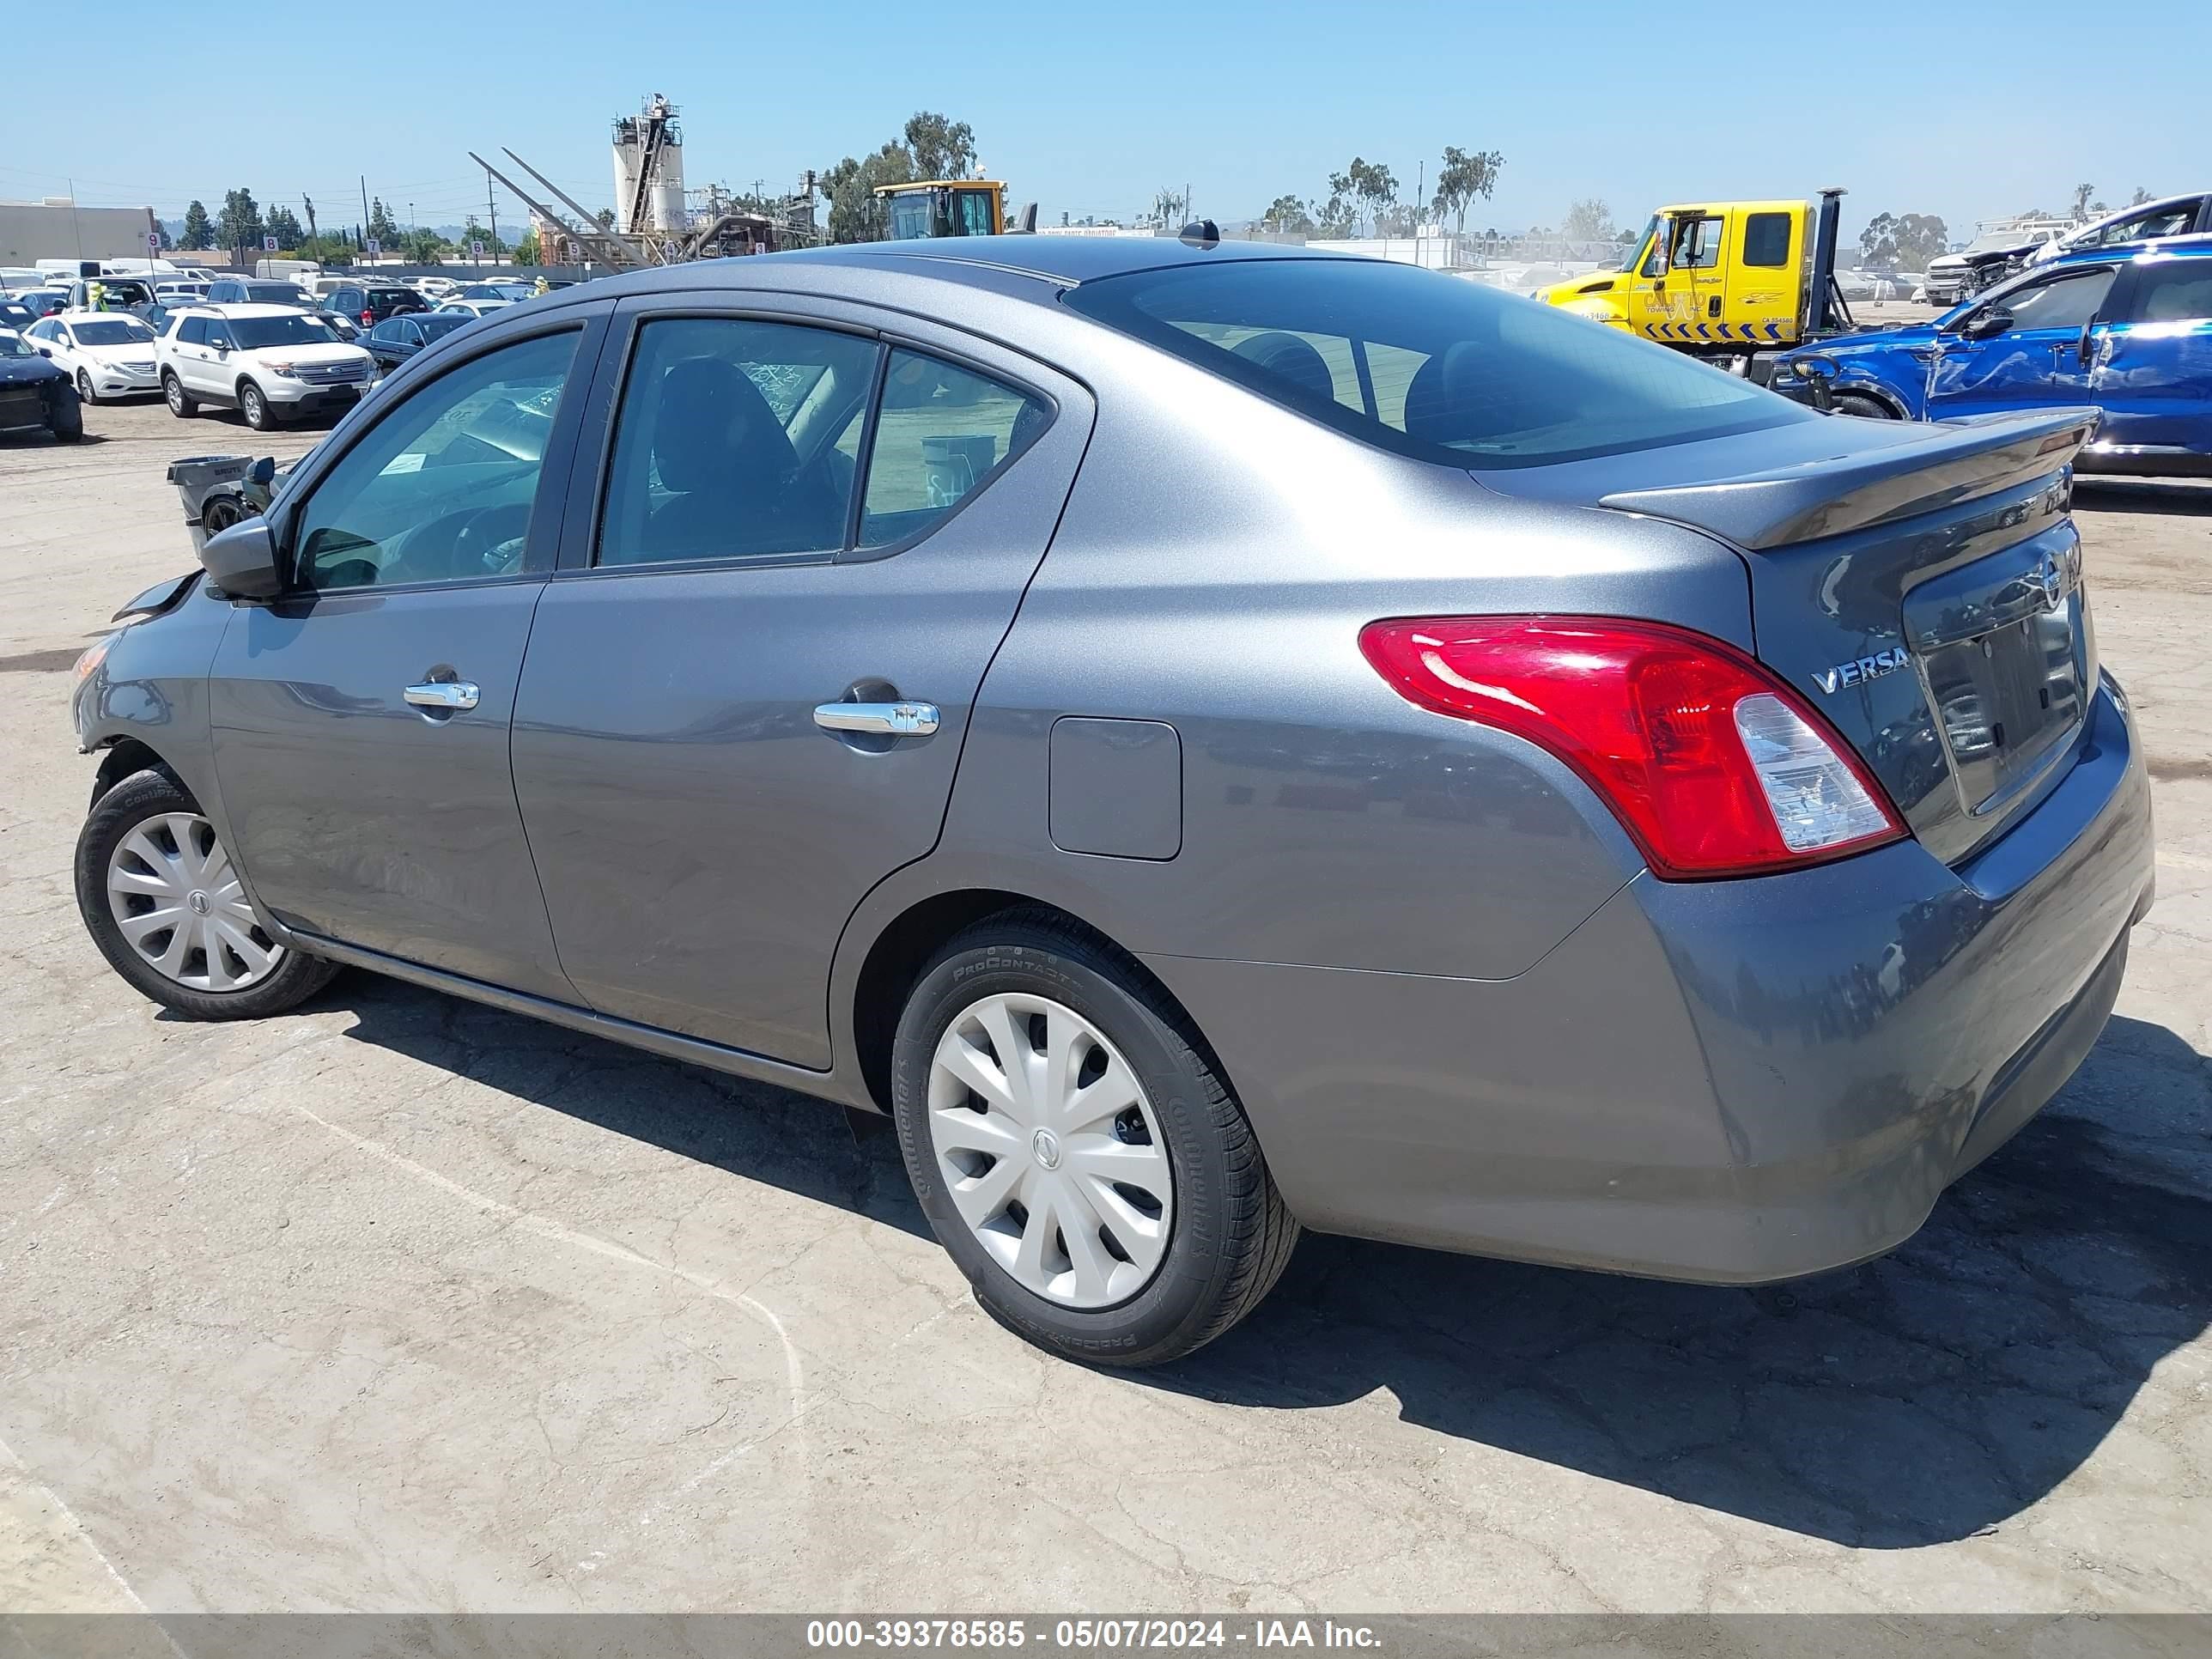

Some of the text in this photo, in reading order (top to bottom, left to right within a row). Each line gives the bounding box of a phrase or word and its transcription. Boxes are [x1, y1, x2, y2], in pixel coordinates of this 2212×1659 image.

[149, 234, 157, 246] 9
[267, 239, 275, 249] 8
[368, 240, 376, 251] 7
[474, 242, 482, 252] 6
[571, 244, 578, 253] 5
[667, 245, 674, 255] 4
[757, 244, 763, 254] 3
[214, 466, 241, 476] BRUTE
[1809, 646, 1910, 694] VERSA
